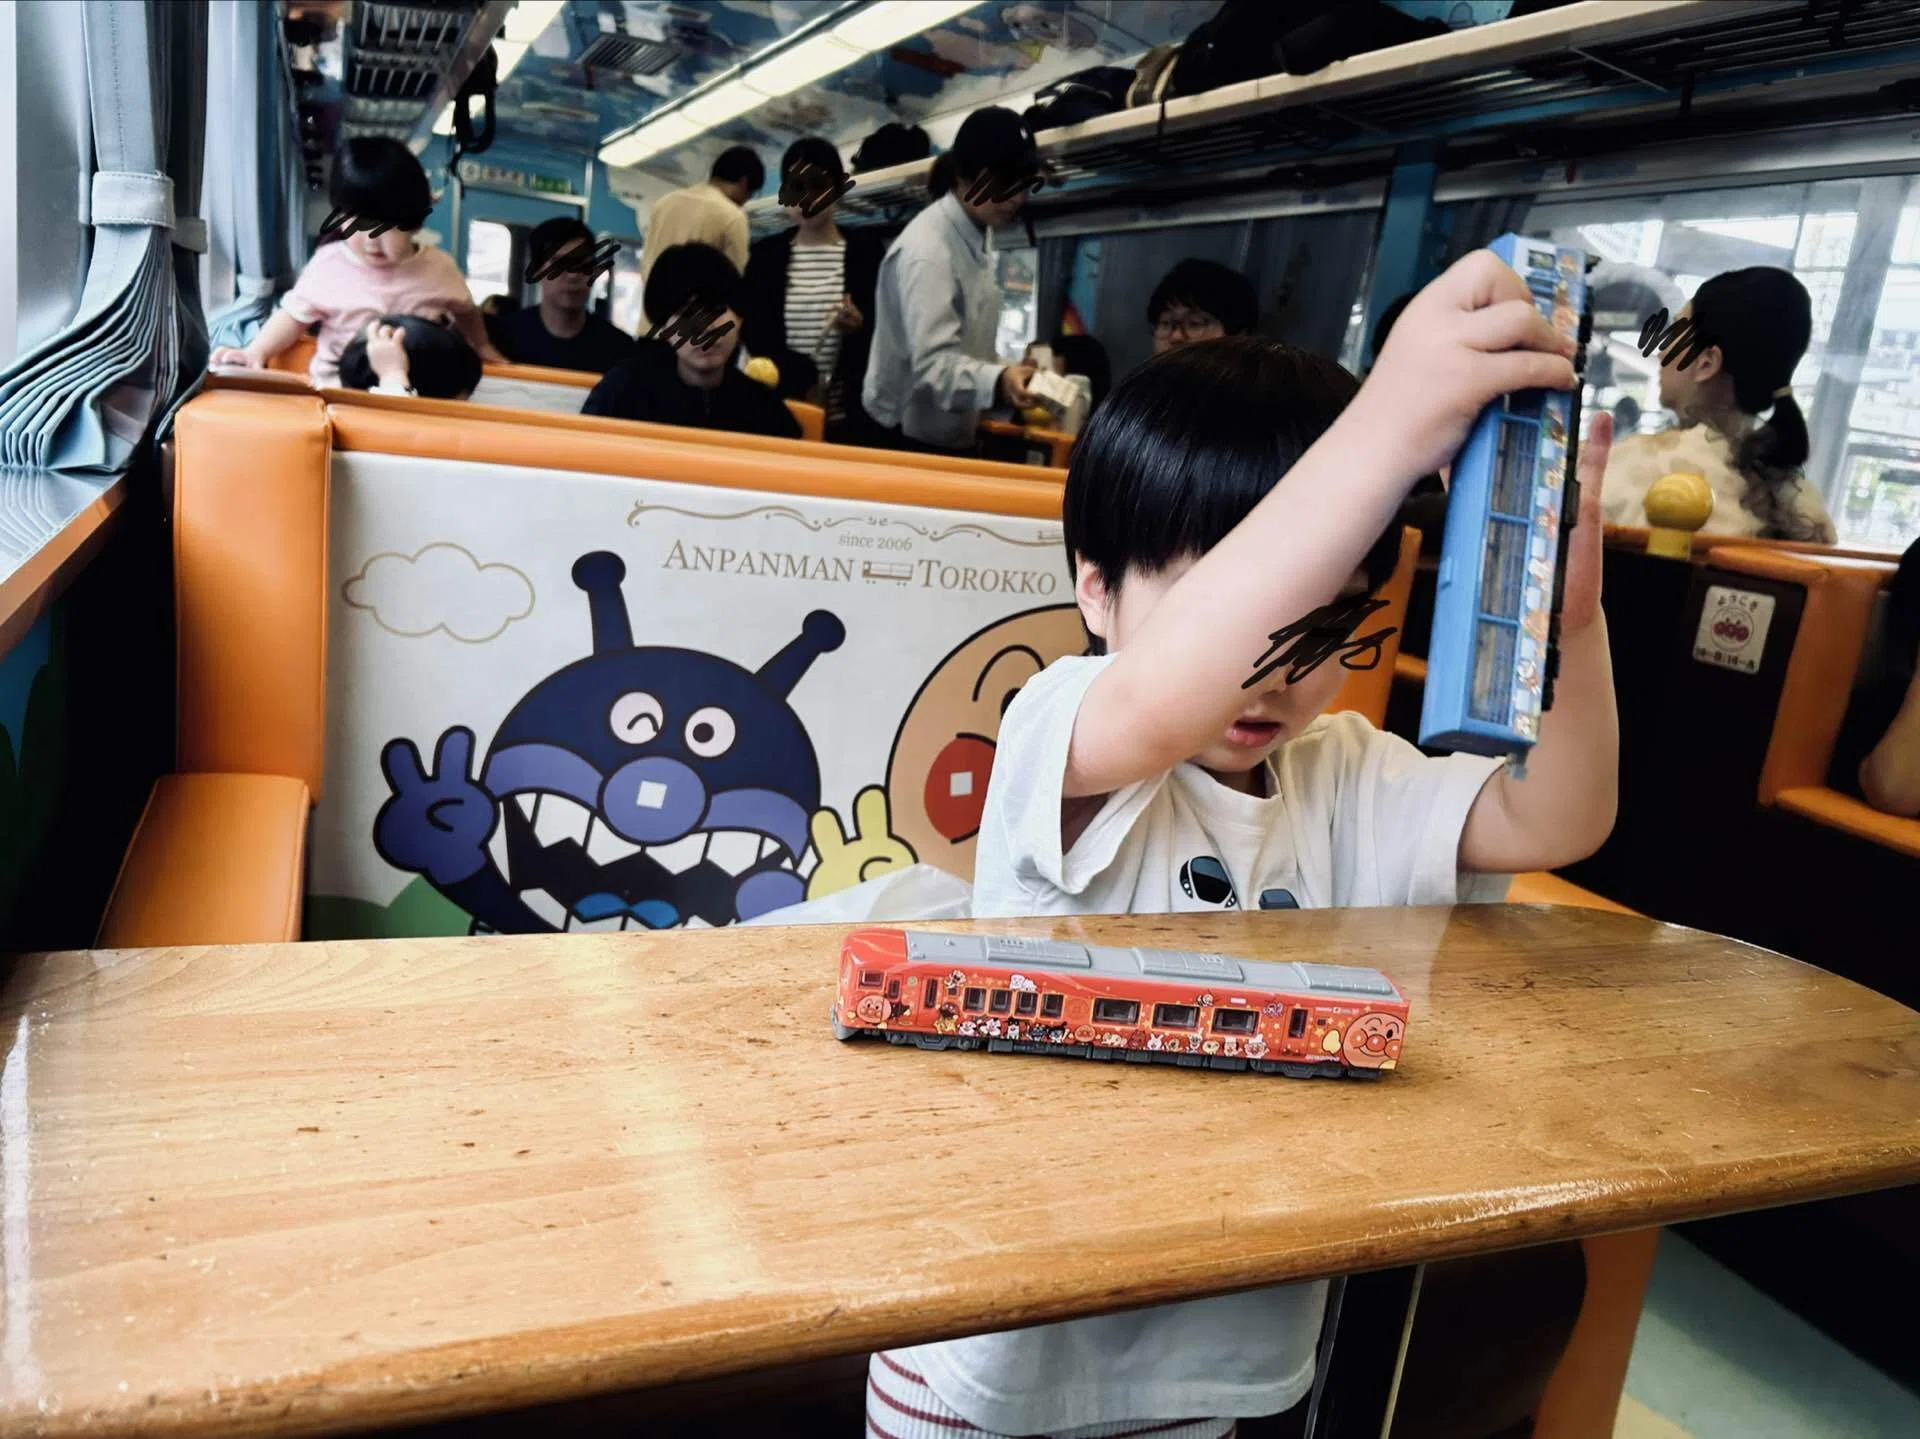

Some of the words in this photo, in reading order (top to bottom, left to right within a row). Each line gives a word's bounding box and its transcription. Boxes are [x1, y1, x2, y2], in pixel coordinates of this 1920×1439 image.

[839, 532, 874, 548] since
[878, 536, 913, 552] 2006
[662, 539, 855, 582] ANPANMAN
[918, 559, 1057, 595] TOROKKO
